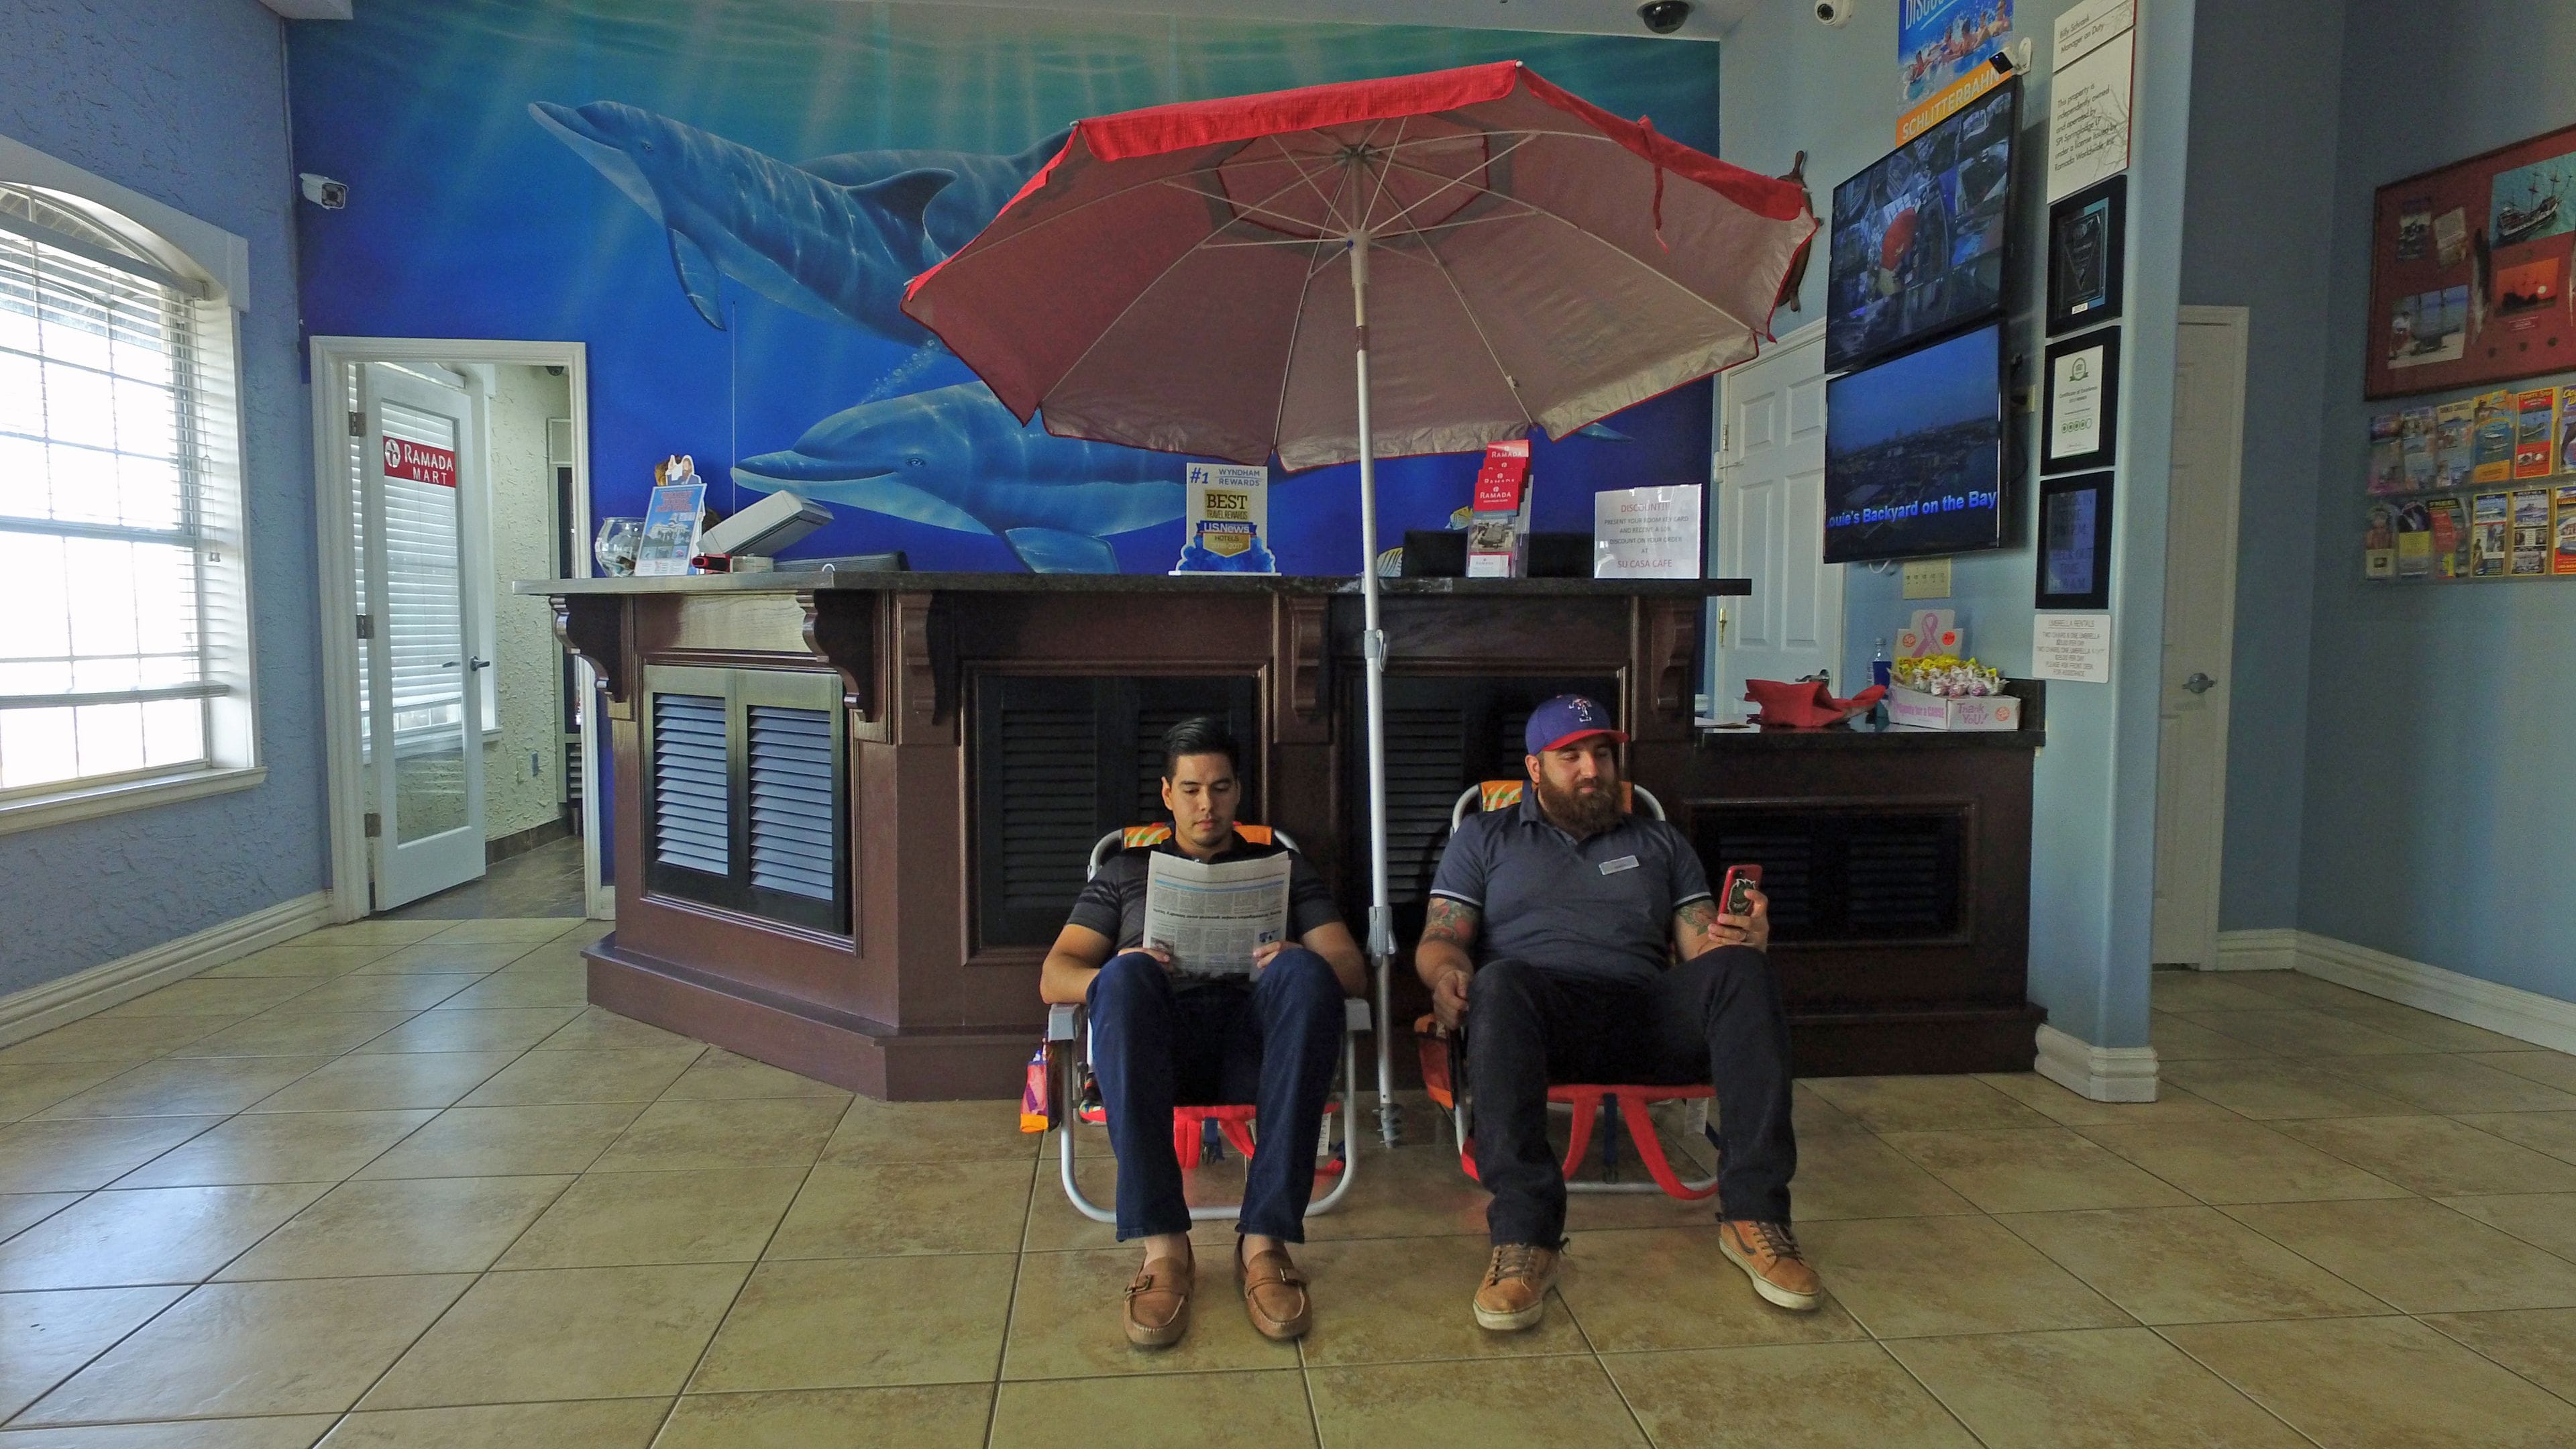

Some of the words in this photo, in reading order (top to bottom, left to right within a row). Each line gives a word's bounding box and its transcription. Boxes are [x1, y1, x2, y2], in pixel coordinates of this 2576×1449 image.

[1902, 66, 2000, 140] SCHLITTERBAHN
[2068, 87, 2090, 105] property
[2057, 97, 2091, 121] independently
[404, 443, 454, 472] RAMADA
[1491, 451, 1523, 459] RAMADA
[413, 466, 447, 485] MART
[1190, 467, 1210, 484] #1
[1218, 468, 1260, 477] WYNDHAM
[1219, 478, 1260, 487] REWARDS
[1206, 493, 1248, 510] BEST
[1480, 492, 1511, 500] RAMADA
[1206, 509, 1224, 519] TRAVEL
[1224, 510, 1248, 521] REWARDS
[1825, 510, 1860, 527] ouie's
[1862, 500, 1919, 523] Backyard
[1921, 500, 1939, 513] on
[1942, 495, 1965, 511] the
[1968, 491, 1998, 510] Bay
[1617, 560, 1628, 569] SU
[1629, 559, 1651, 569] CASA
[1652, 559, 1673, 568] CAFE
[1957, 702, 1986, 714] Thank
